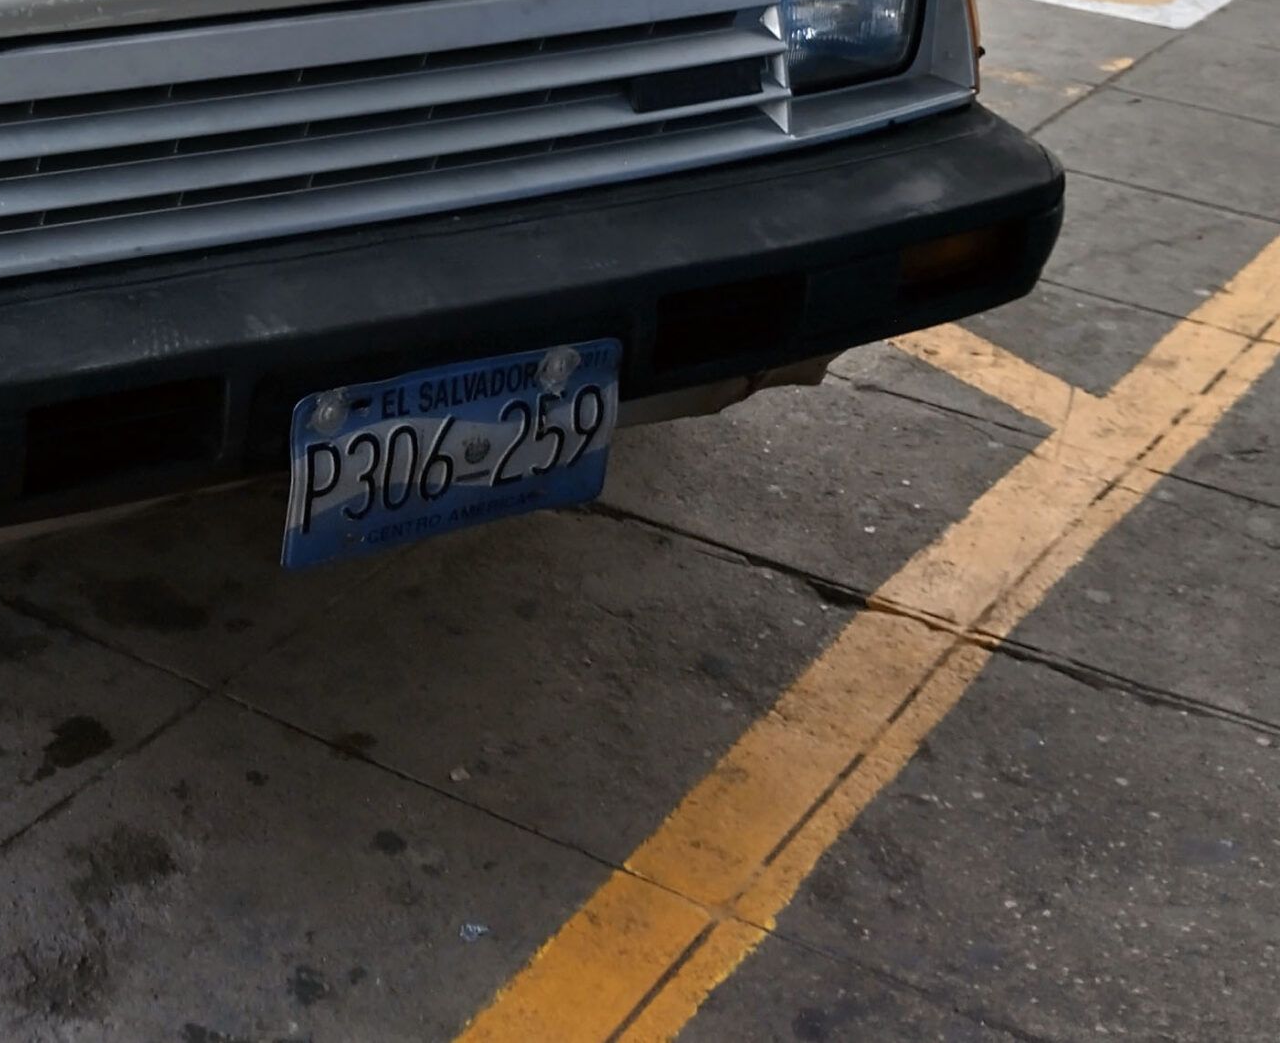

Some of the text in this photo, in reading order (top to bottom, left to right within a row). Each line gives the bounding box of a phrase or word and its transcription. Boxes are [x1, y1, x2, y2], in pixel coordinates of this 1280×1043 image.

[381, 363, 538, 420] EL SALVADOR
[367, 513, 442, 544] CENTRO
